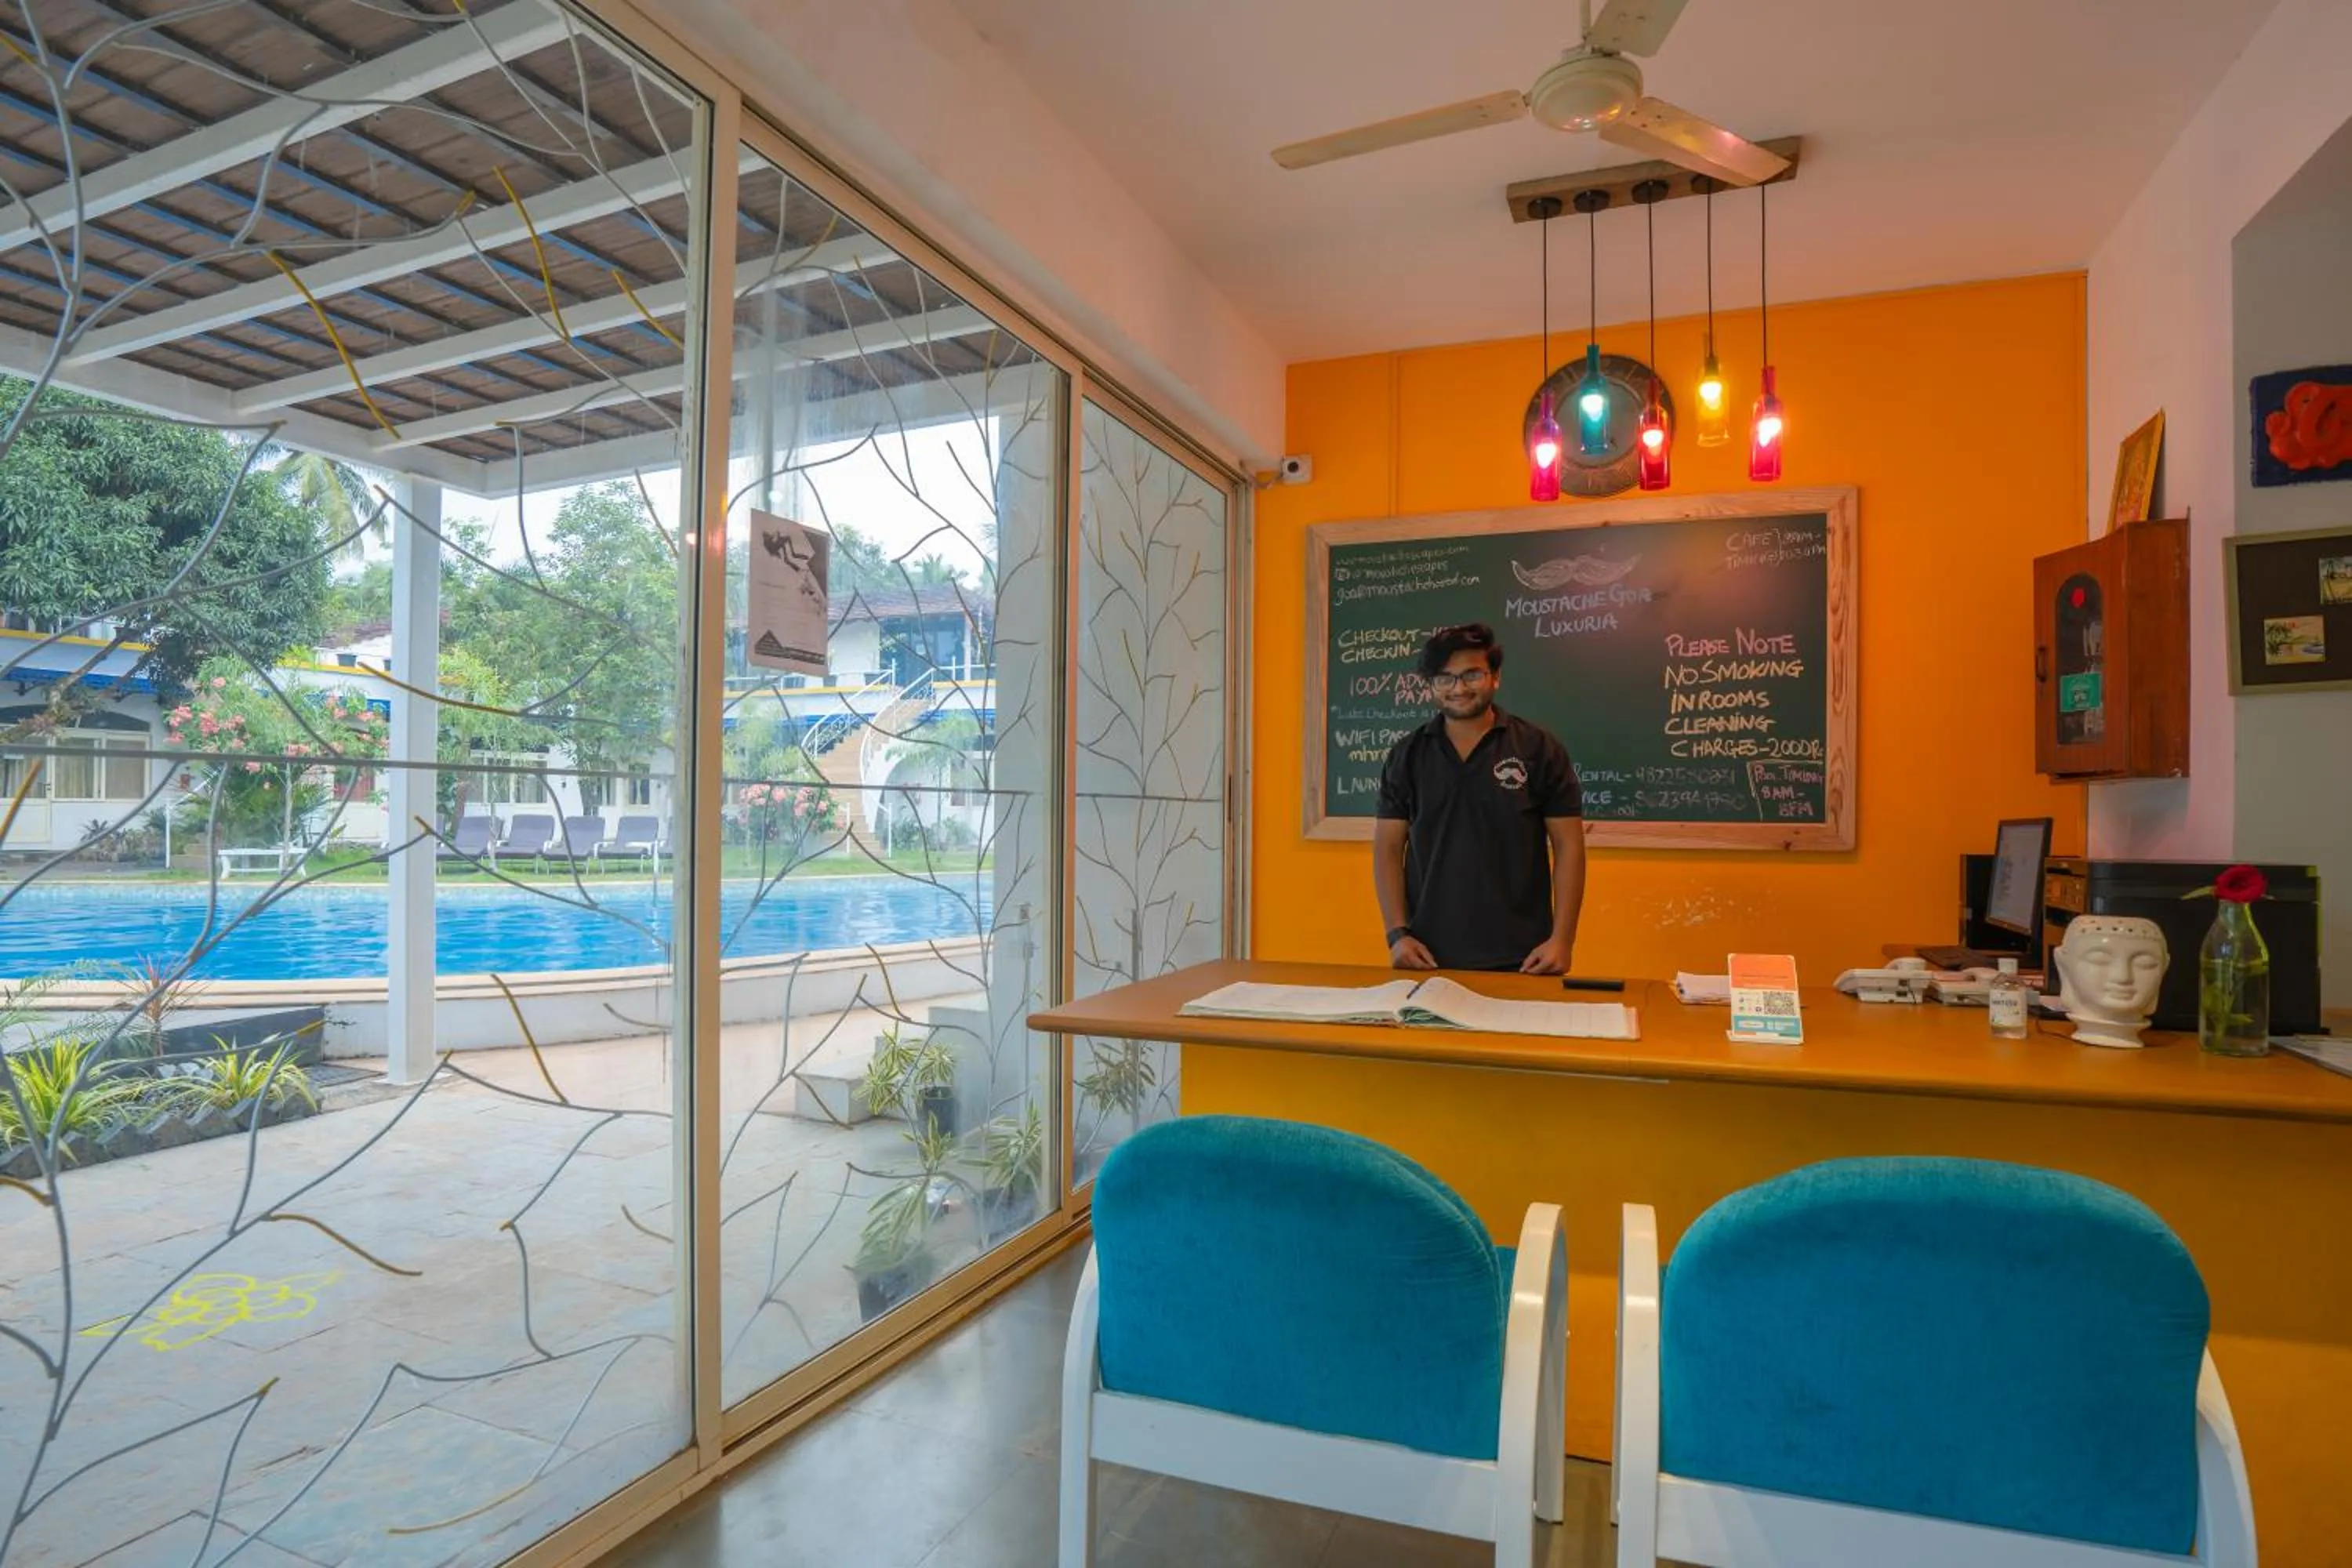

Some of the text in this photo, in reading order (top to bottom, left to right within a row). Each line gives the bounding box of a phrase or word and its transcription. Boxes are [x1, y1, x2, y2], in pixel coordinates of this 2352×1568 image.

[1726, 532, 1772, 550] CAFE
[1505, 590, 1606, 619] MOUSTACHE
[1534, 614, 1619, 639] LUXURIA
[1665, 626, 1796, 657] PLEASE NOTE
[1349, 672, 1393, 697] 100%
[1664, 711, 1777, 735] CLEANING
[1335, 728, 1377, 747] WIFI
